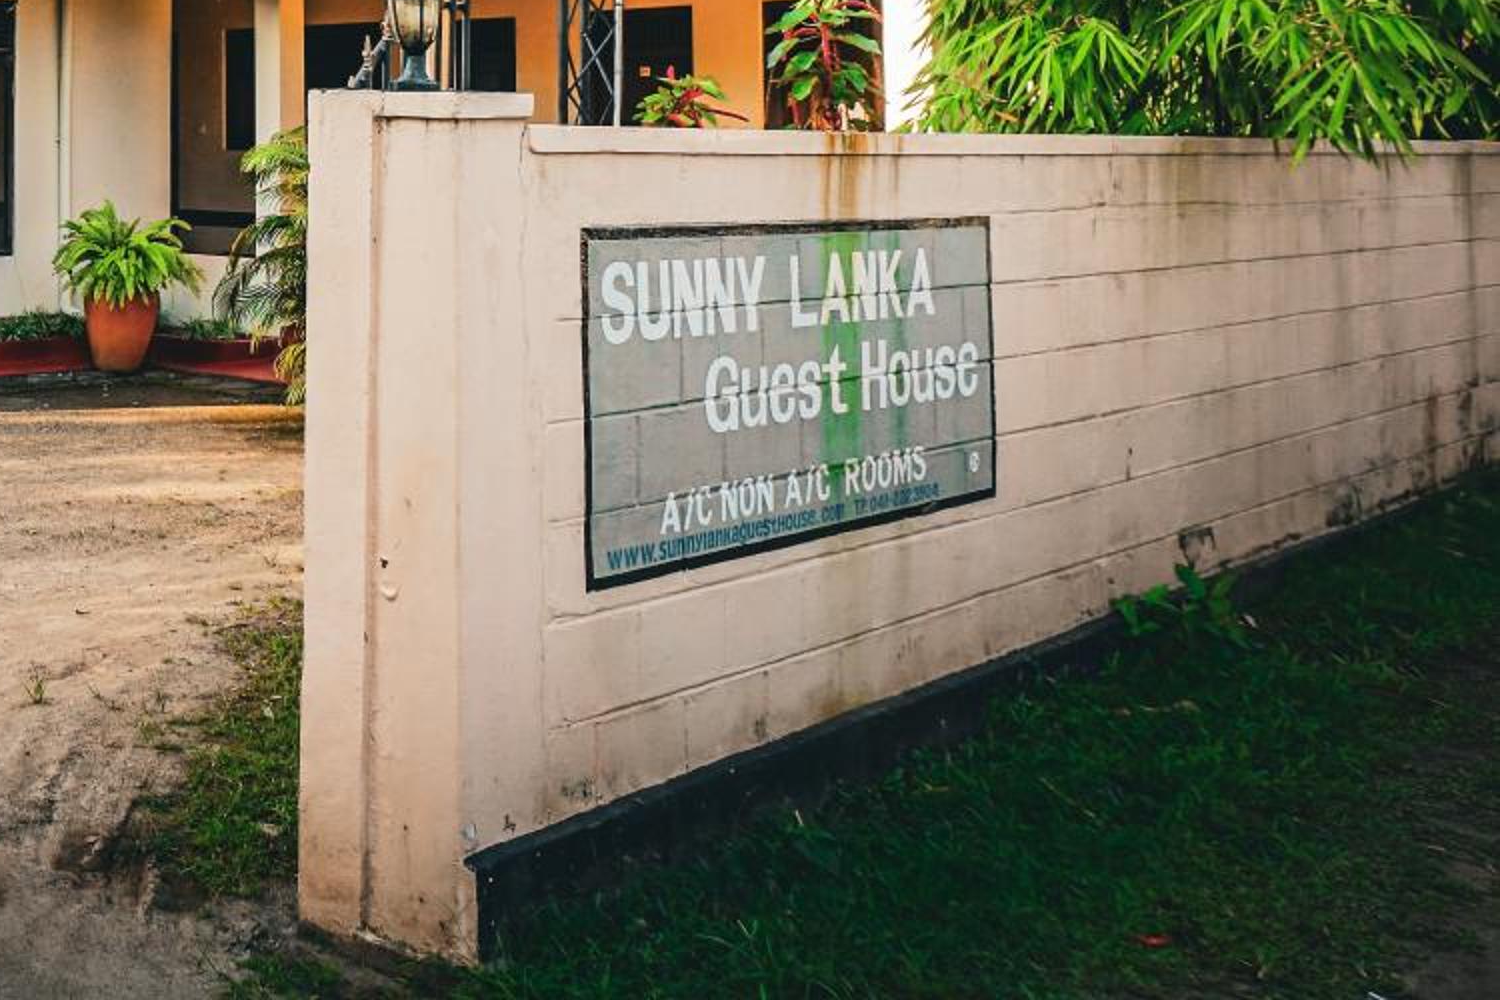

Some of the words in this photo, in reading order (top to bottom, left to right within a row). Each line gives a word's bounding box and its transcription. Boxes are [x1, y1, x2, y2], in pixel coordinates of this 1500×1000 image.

[600, 254, 766, 345] SUNNY
[788, 247, 936, 329] LANKA
[705, 344, 848, 433] Guest
[860, 339, 979, 412] House
[660, 485, 712, 535] A/C
[719, 475, 775, 522] NON
[786, 463, 831, 507] A/C
[845, 445, 927, 496] ROOMS
